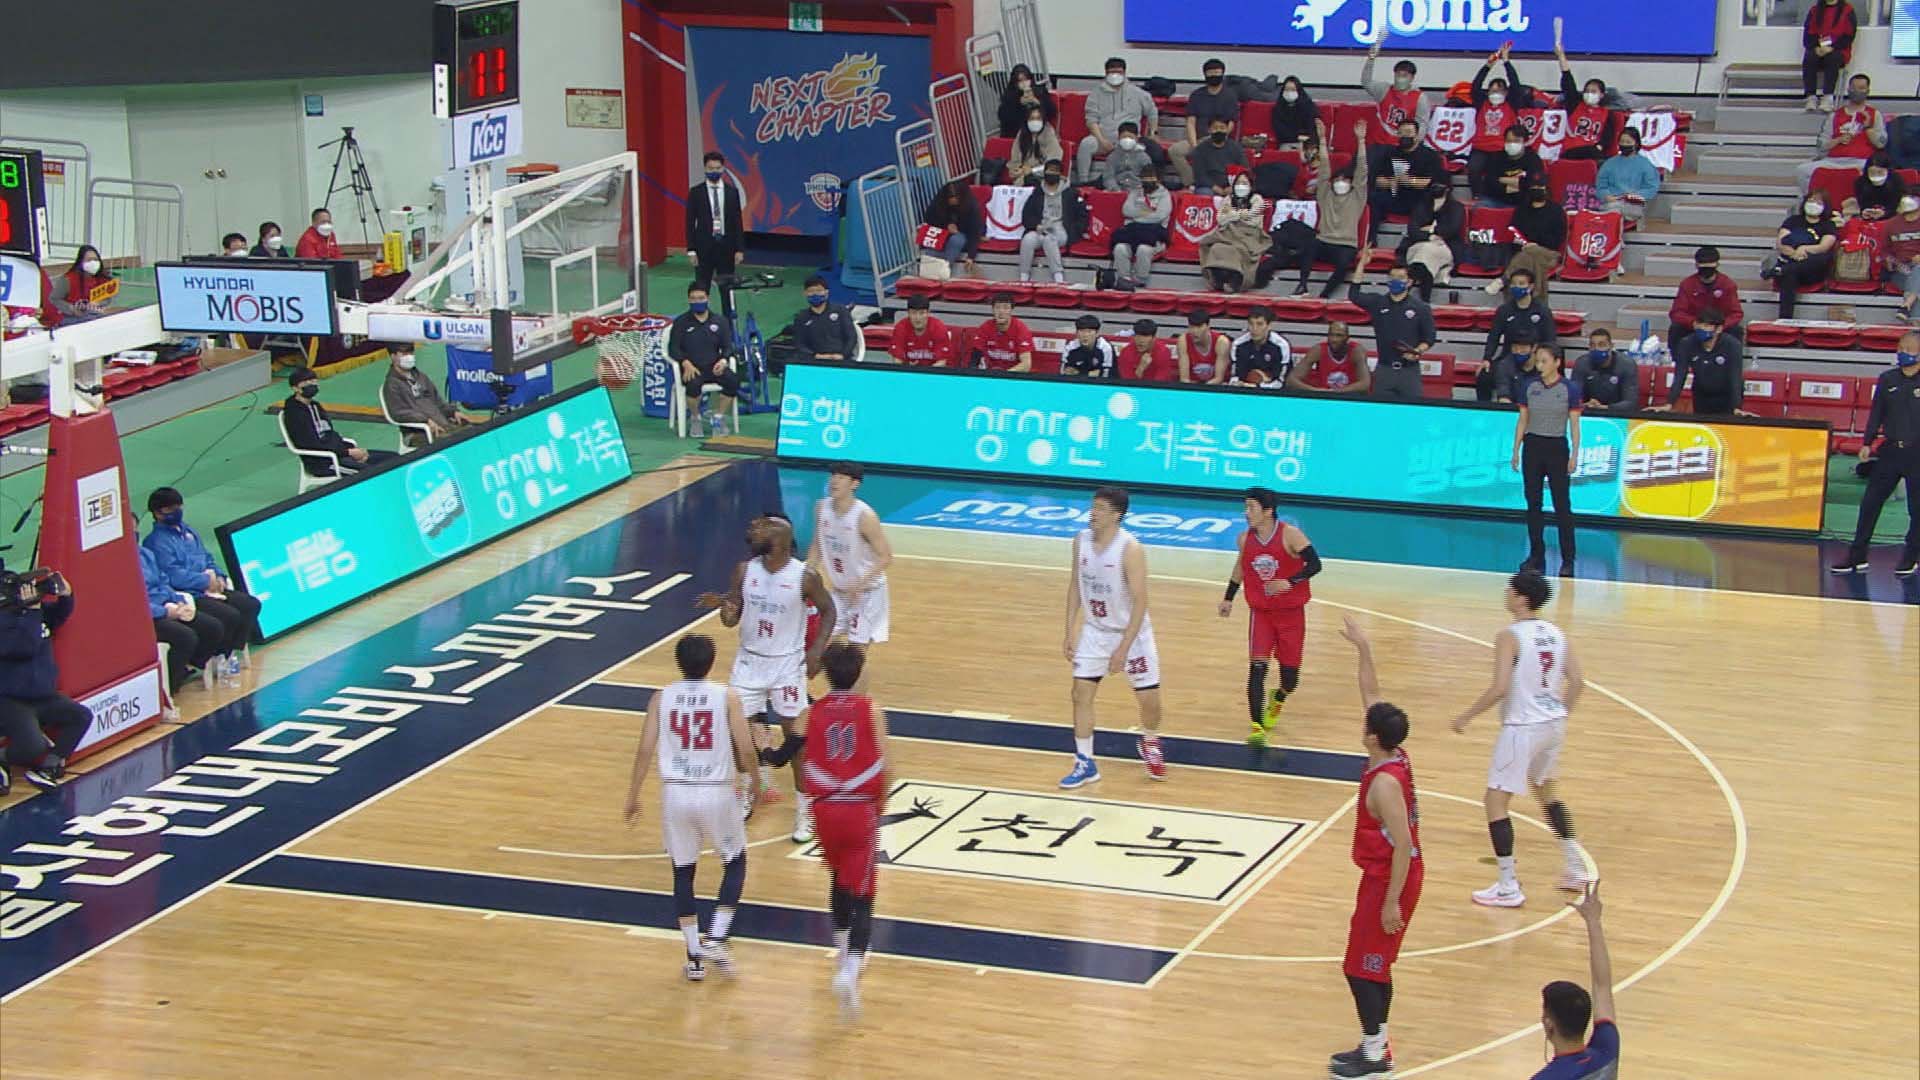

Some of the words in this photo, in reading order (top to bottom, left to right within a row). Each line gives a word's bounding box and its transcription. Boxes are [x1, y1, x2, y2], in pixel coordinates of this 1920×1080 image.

[1352, 0, 1529, 44] joma
[477, 47, 505, 97] 11
[750, 71, 829, 114] NEXT
[757, 92, 896, 143] CHAPTER
[1436, 119, 1466, 143] 22
[1640, 117, 1659, 140] 11
[472, 123, 505, 158] KCC
[1007, 196, 1016, 219] 1
[1579, 231, 1608, 257] 12
[184, 276, 254, 291] HYUNDAI
[206, 294, 304, 324] MOBIS
[446, 322, 484, 335] ULSAN
[1135, 420, 1312, 482] 저축은행
[757, 619, 774, 638] 14
[782, 685, 800, 702] 14
[96, 696, 141, 733] MOBIS
[669, 710, 714, 751] 43
[825, 721, 857, 762] 11
